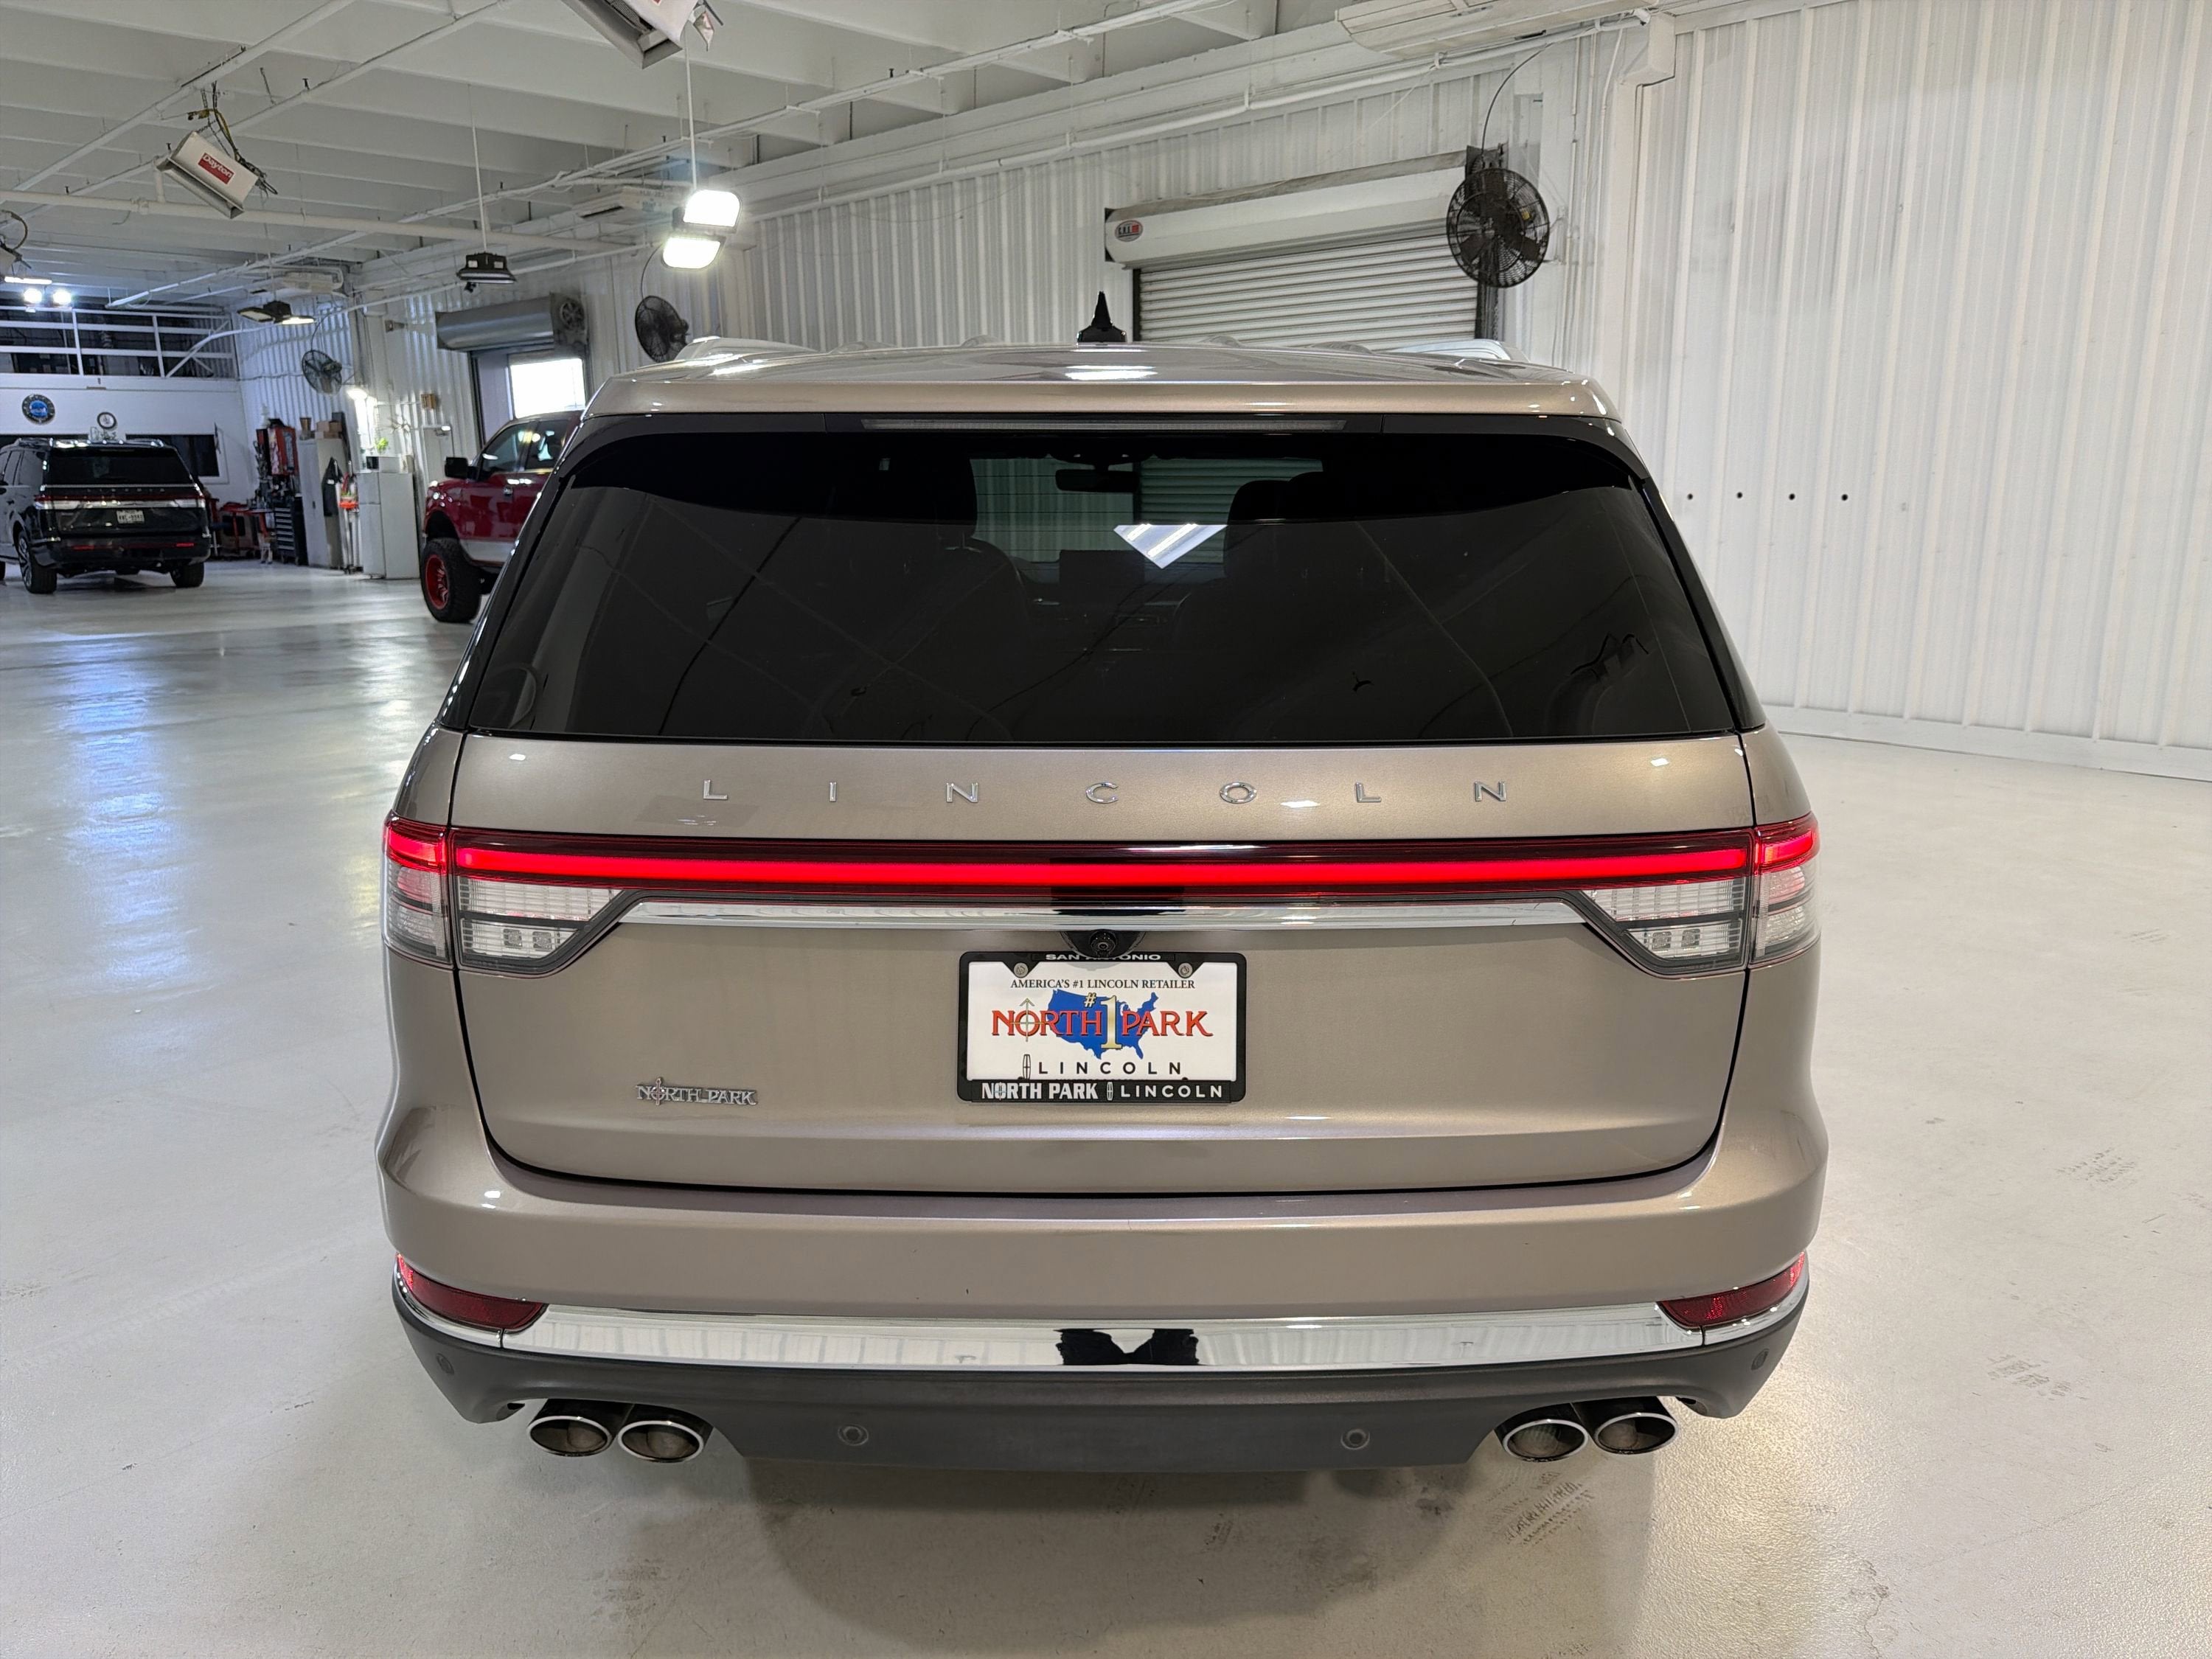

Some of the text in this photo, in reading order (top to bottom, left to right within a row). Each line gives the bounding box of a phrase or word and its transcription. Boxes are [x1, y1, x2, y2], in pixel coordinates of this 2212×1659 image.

[202, 155, 232, 178] Dayton
[703, 779, 1506, 805] LINCOLN
[1011, 979, 1195, 990] AMERICA'S #1 LINCOLN RETAILER
[992, 1009, 1214, 1037] NORTH PARK
[1038, 1062, 1181, 1075] LINCOLN
[636, 1084, 757, 1105] NORTH PARK
[981, 1082, 1222, 1099] NORTH PARK LINCOLN
